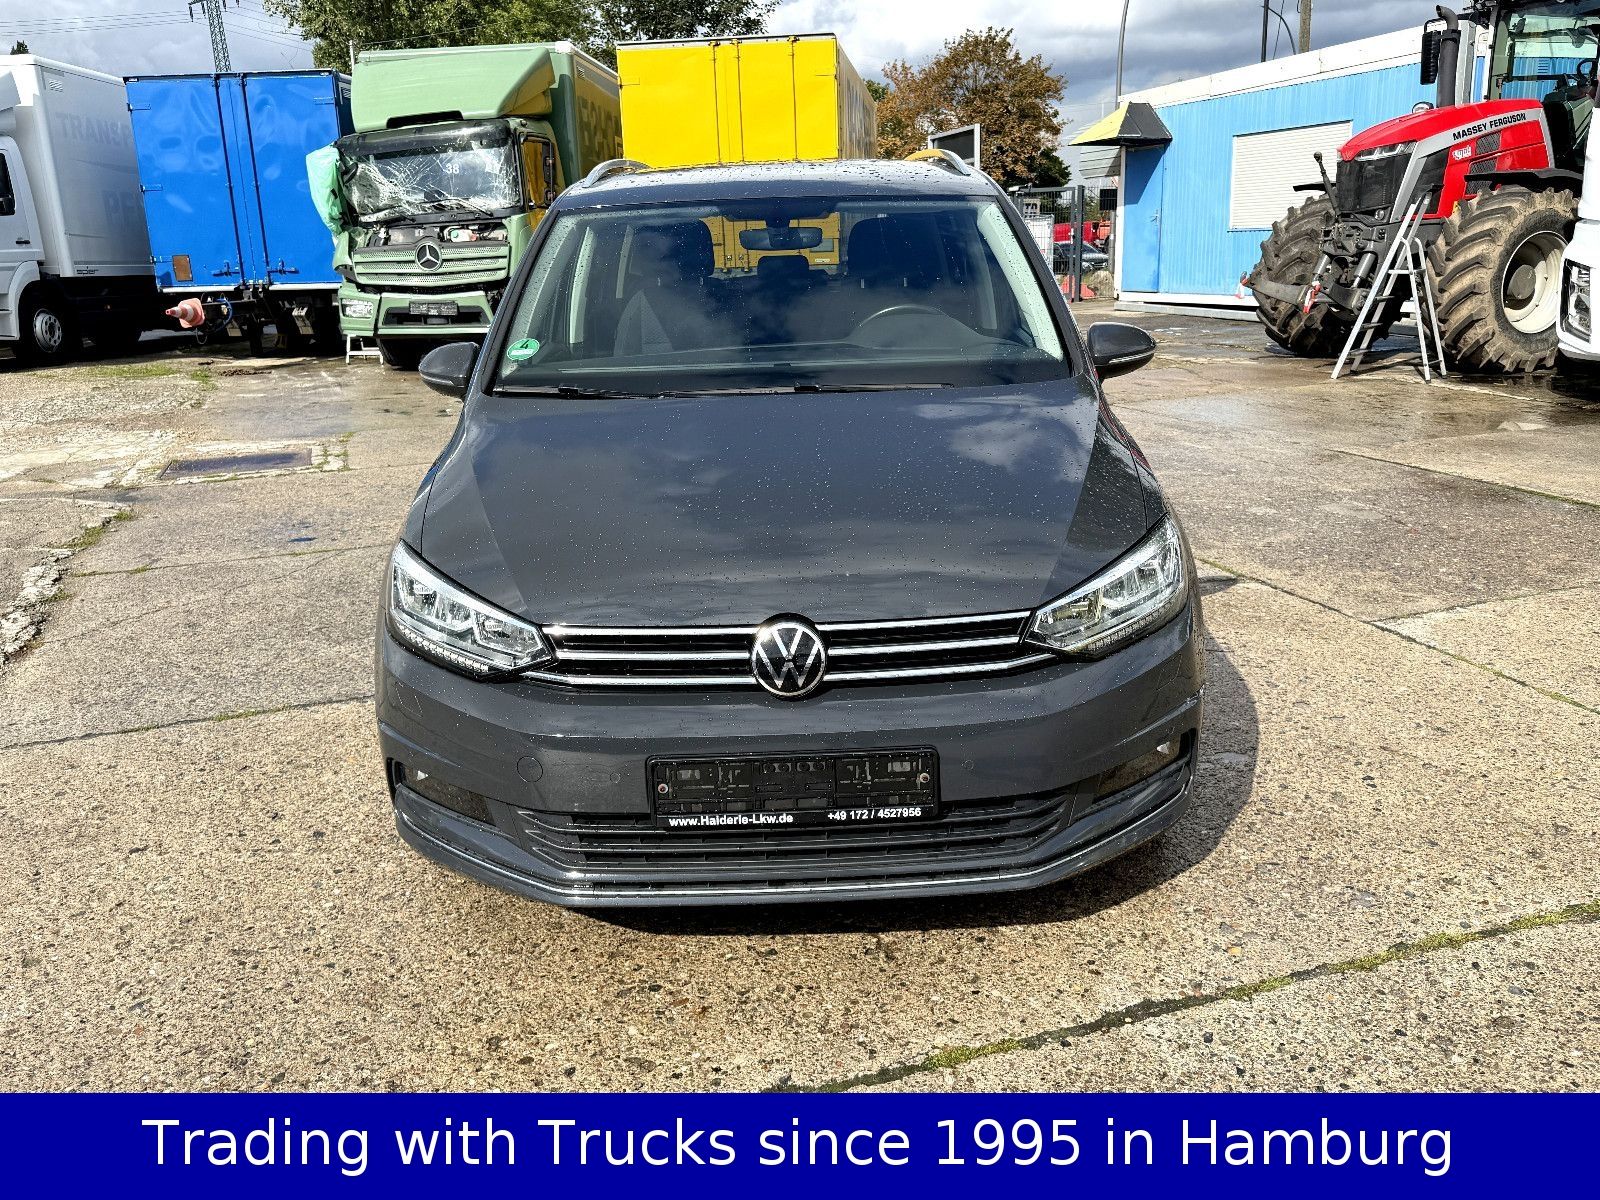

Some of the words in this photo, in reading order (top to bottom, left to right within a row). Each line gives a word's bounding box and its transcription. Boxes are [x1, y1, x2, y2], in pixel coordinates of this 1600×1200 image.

[1452, 122, 1487, 141] MASSEY
[1489, 112, 1526, 129] FERGUSON
[445, 161, 460, 174] 38
[519, 339, 529, 349] 4
[668, 813, 794, 827] www.Haiderle-Lkw.de
[827, 811, 847, 820] +49
[849, 810, 869, 819] 172
[877, 807, 922, 818] 4527956
